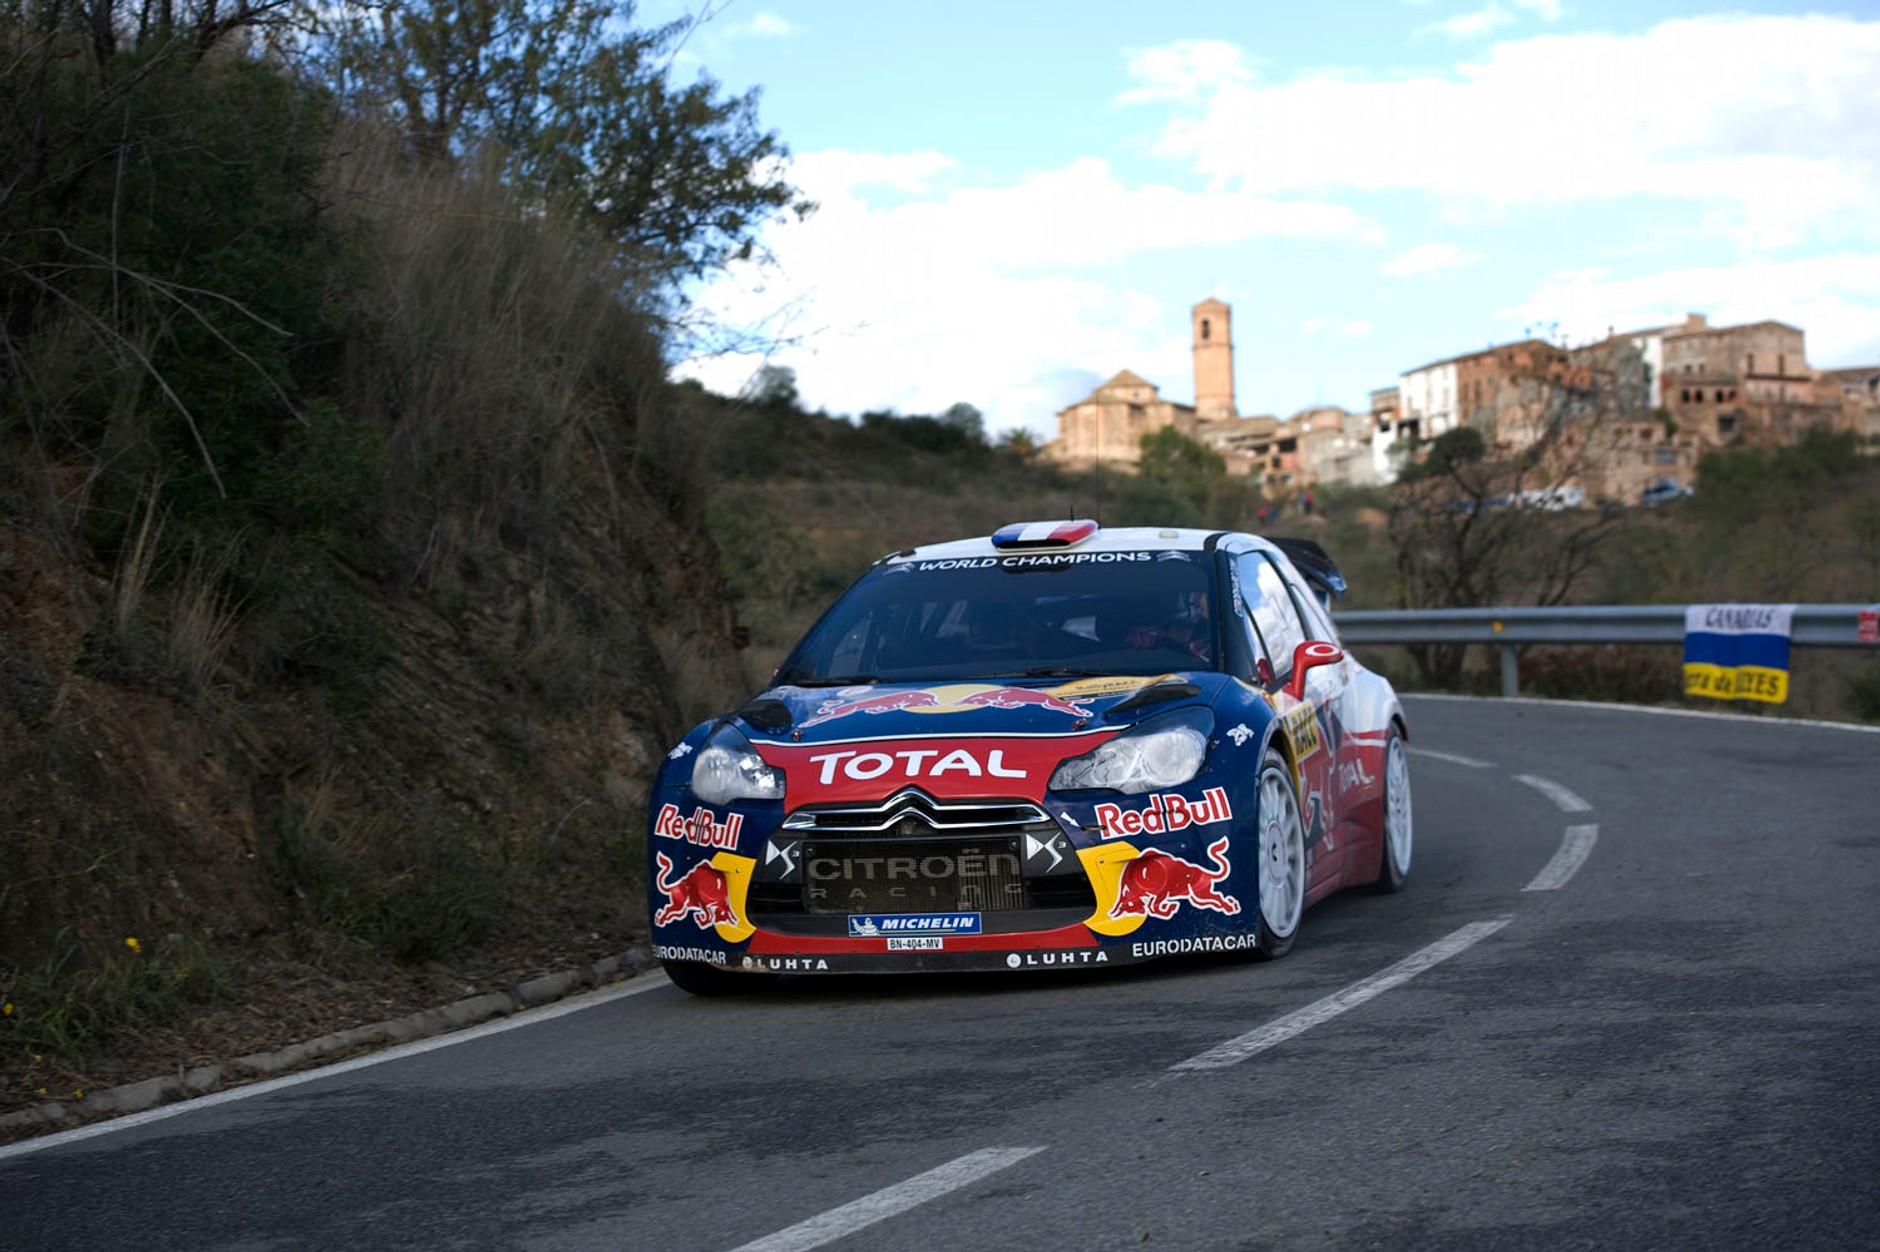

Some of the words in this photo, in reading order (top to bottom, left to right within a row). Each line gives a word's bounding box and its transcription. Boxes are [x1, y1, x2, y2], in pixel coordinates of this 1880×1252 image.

[919, 557, 998, 572] WORLD
[1001, 551, 1152, 568] CHAMPIONS
[809, 749, 1027, 785] TOTAL
[881, 916, 974, 930] MICHELIN
[889, 938, 940, 950] BN-404-MV
[1132, 934, 1257, 957] EURODATACAR
[758, 958, 829, 970] LUHTA
[1027, 950, 1109, 965] LUHTA
